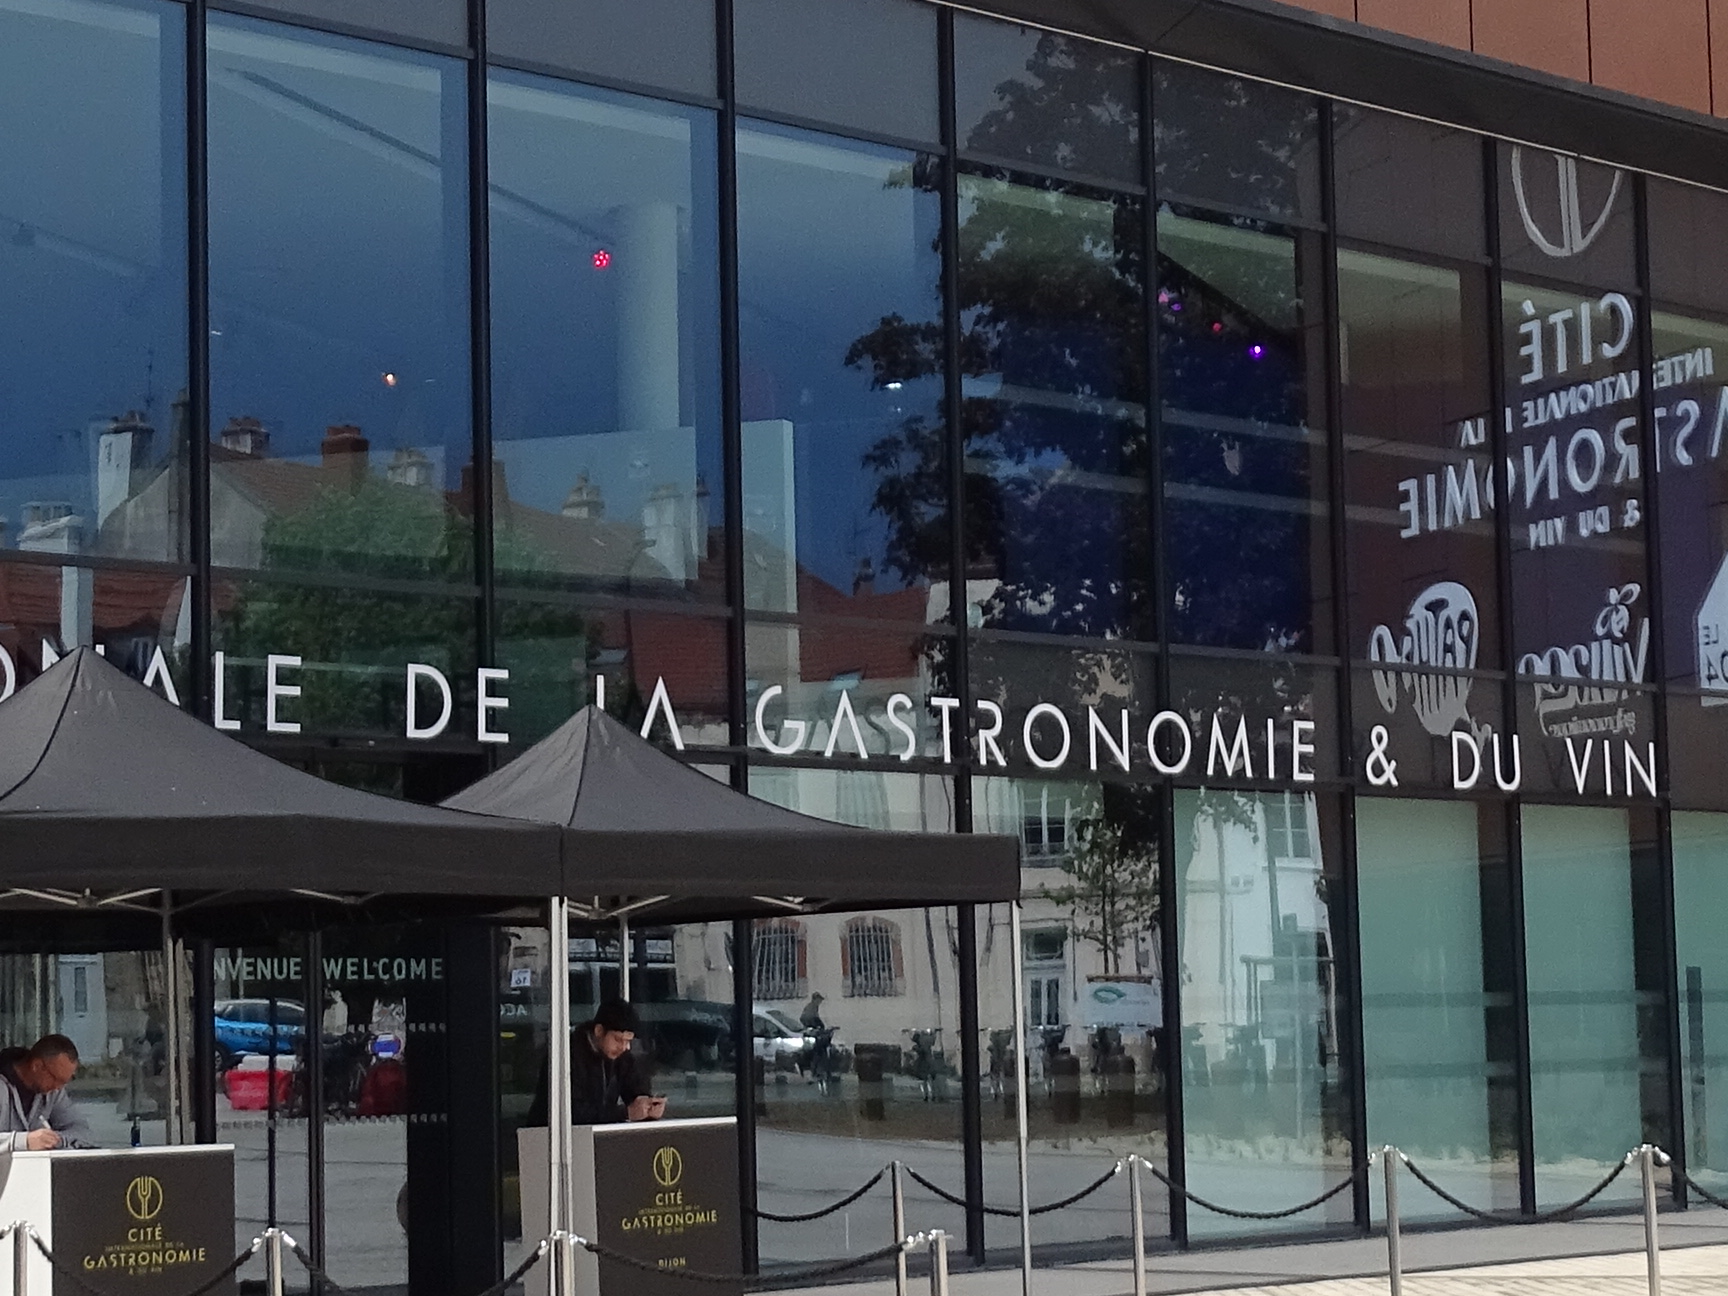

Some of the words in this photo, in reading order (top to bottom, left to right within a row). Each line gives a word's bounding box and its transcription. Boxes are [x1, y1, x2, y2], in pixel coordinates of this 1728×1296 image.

[406, 663, 509, 743] DE
[755, 685, 1315, 781] GASTRONOMIE
[1367, 724, 1398, 787] &
[1453, 730, 1522, 791] DU
[1564, 737, 1658, 798] VIN
[323, 958, 444, 981] WELCOME
[655, 1189, 683, 1206] CITÉ
[622, 1210, 718, 1230] GASTRONOMIE
[128, 1223, 162, 1242] CITÉ
[83, 1248, 206, 1269] GASTRONOMIE
